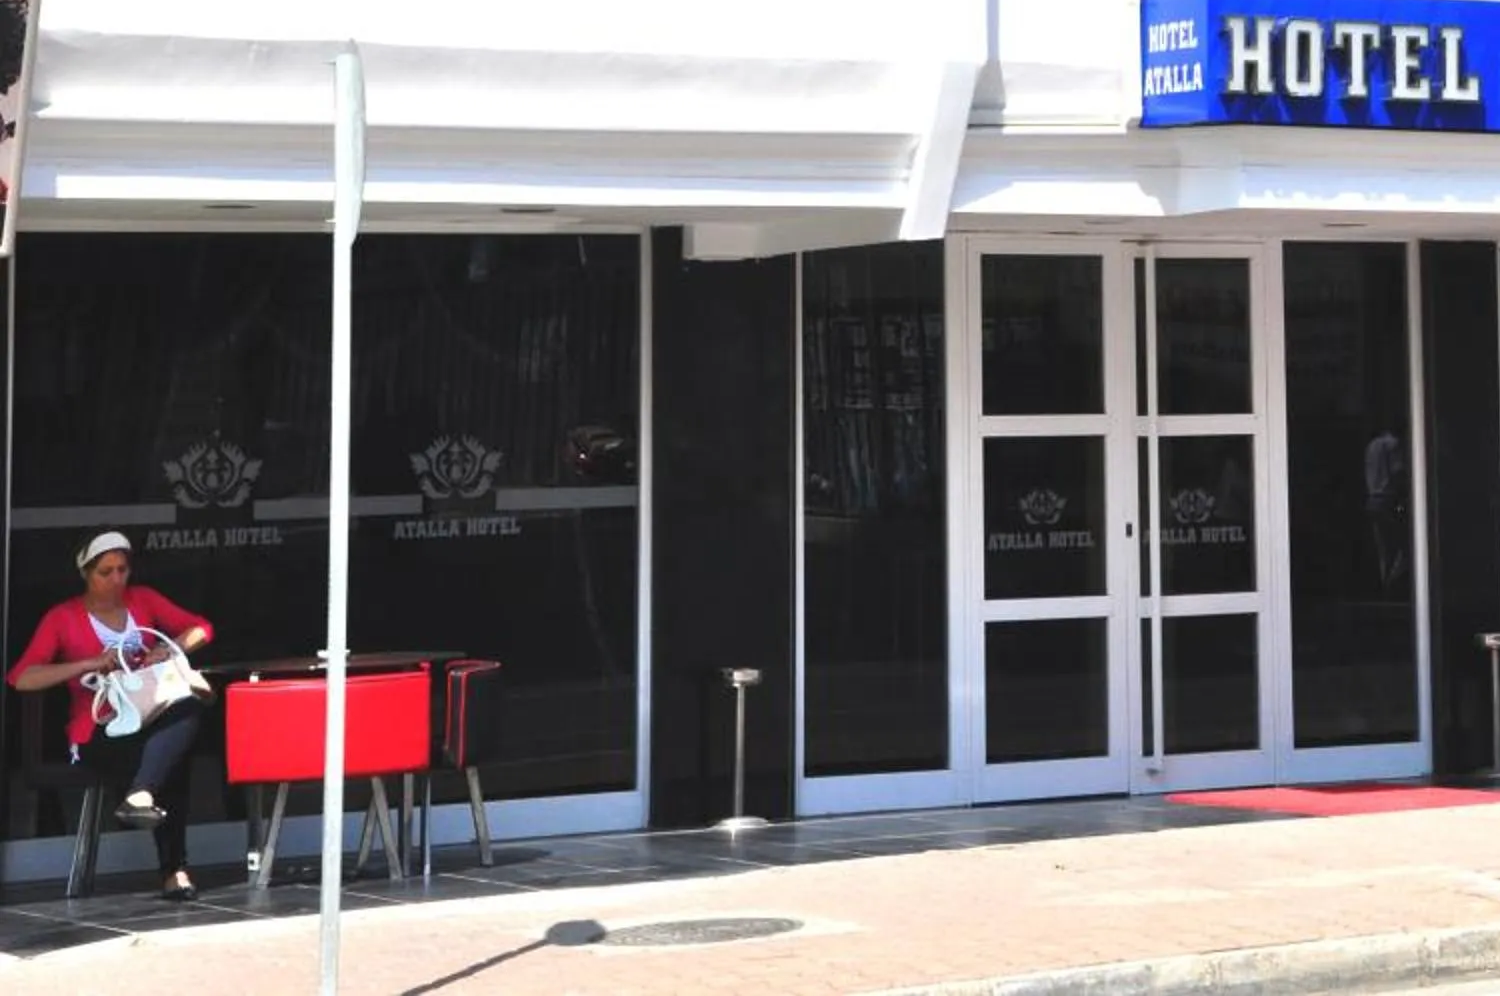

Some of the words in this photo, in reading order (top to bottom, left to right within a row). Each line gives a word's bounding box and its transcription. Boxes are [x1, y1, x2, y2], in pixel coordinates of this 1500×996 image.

[1148, 19, 1199, 53] HOTEL
[1225, 16, 1480, 101] HOTEL
[1143, 62, 1203, 96] ATALLA
[146, 529, 217, 550] ATALLA
[224, 526, 283, 546] HOTEL
[393, 519, 459, 540] ATALLA
[466, 516, 521, 536] HOTEL
[987, 531, 1043, 551] ATALLA
[1048, 529, 1095, 549] HOTEL
[1142, 527, 1196, 544] AALLA
[1200, 526, 1247, 544] HOTEL
